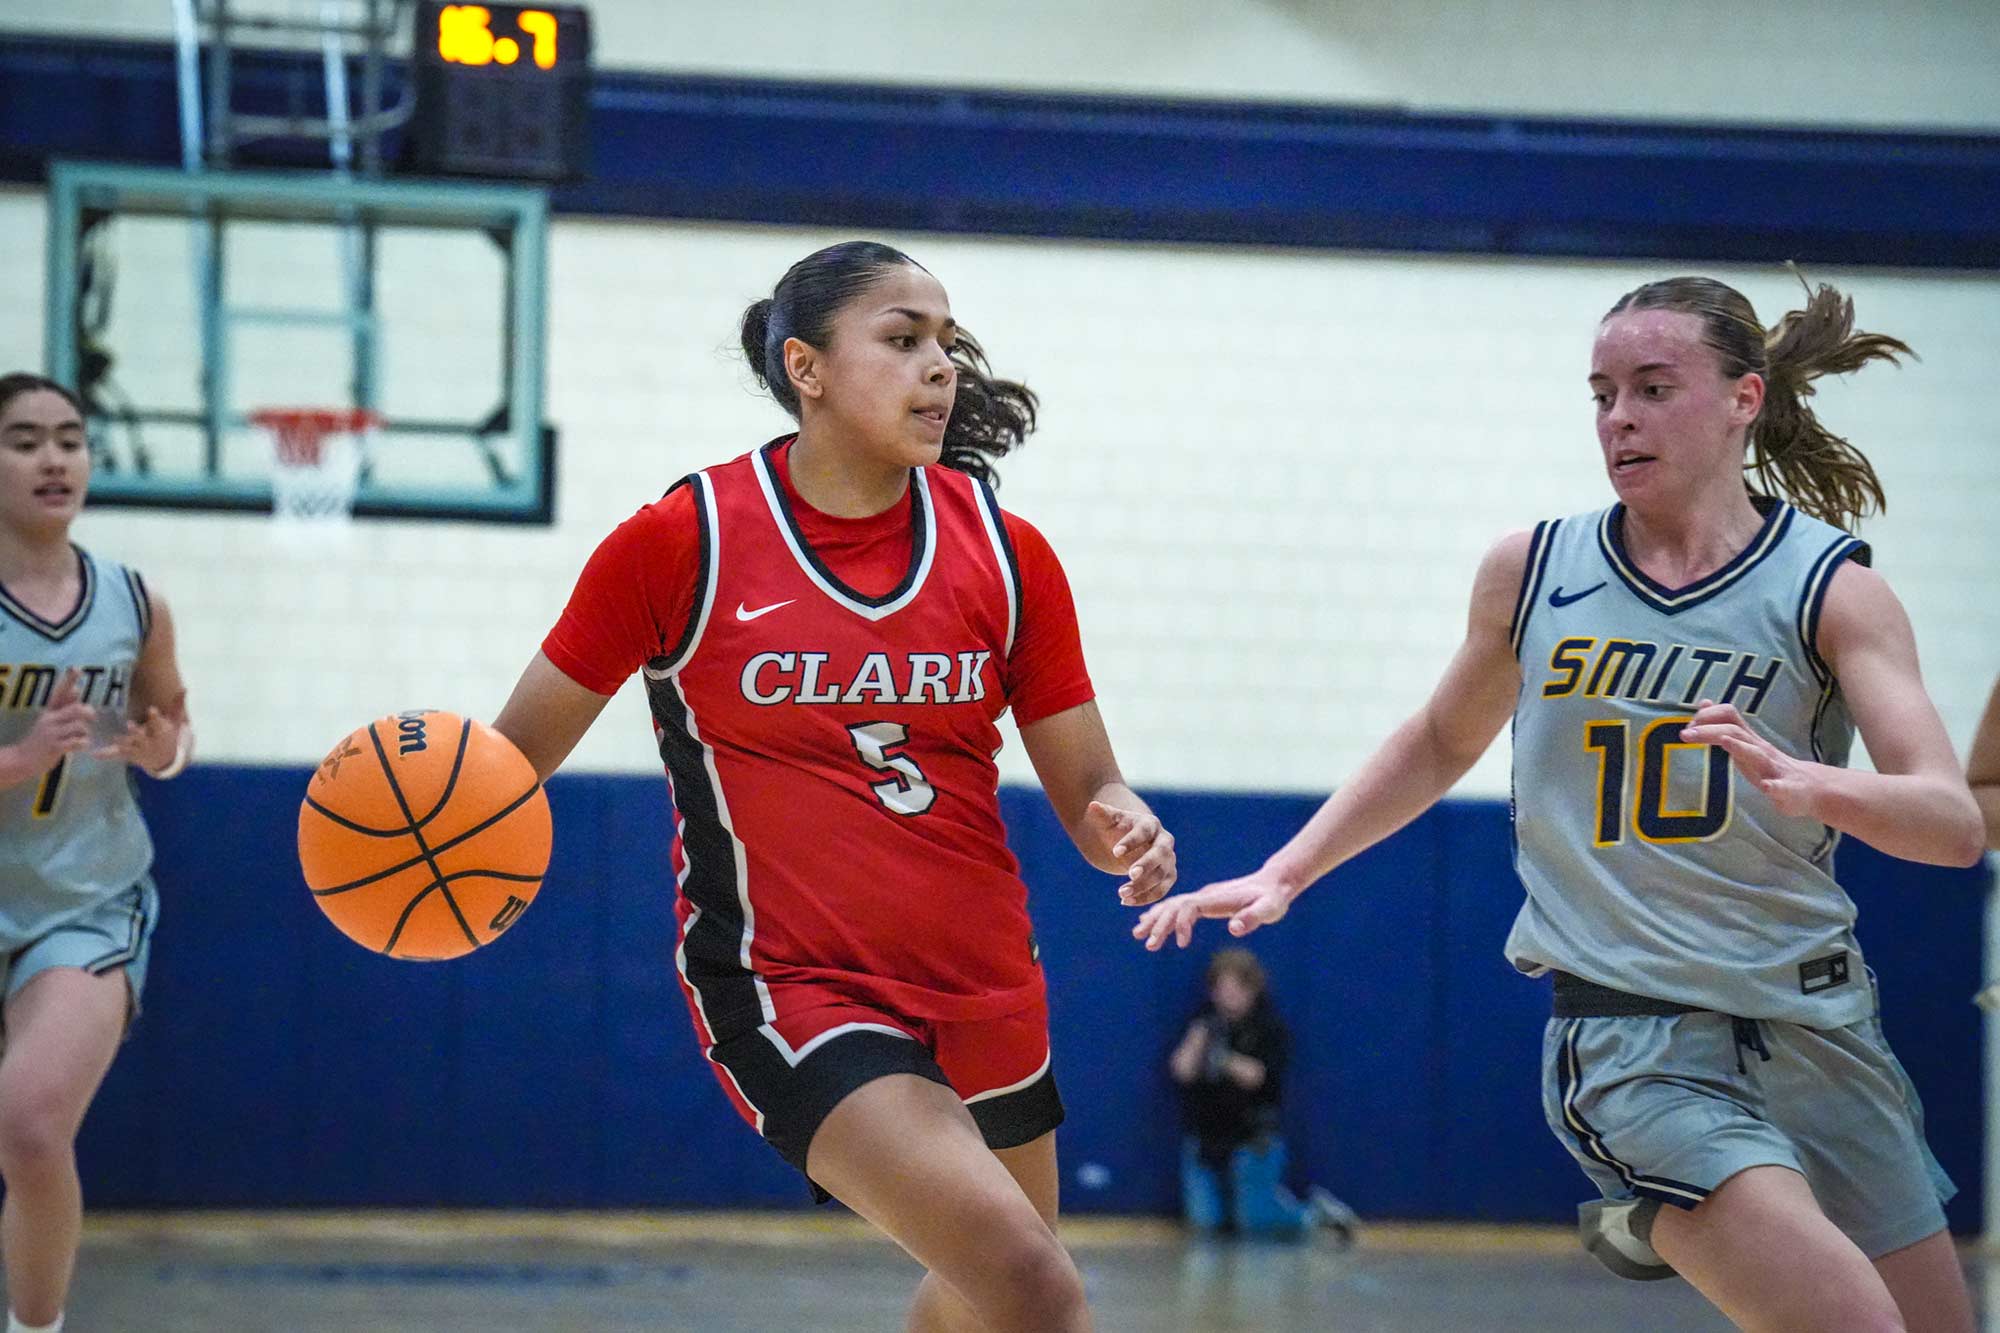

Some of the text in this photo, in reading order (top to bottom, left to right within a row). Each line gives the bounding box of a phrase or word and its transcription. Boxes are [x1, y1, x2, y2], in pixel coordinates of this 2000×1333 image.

[0, 664, 131, 709] MTH
[739, 650, 991, 706] CLARK
[1541, 636, 1787, 716] SMITH
[844, 719, 938, 817] 5
[1583, 716, 1735, 848] 10
